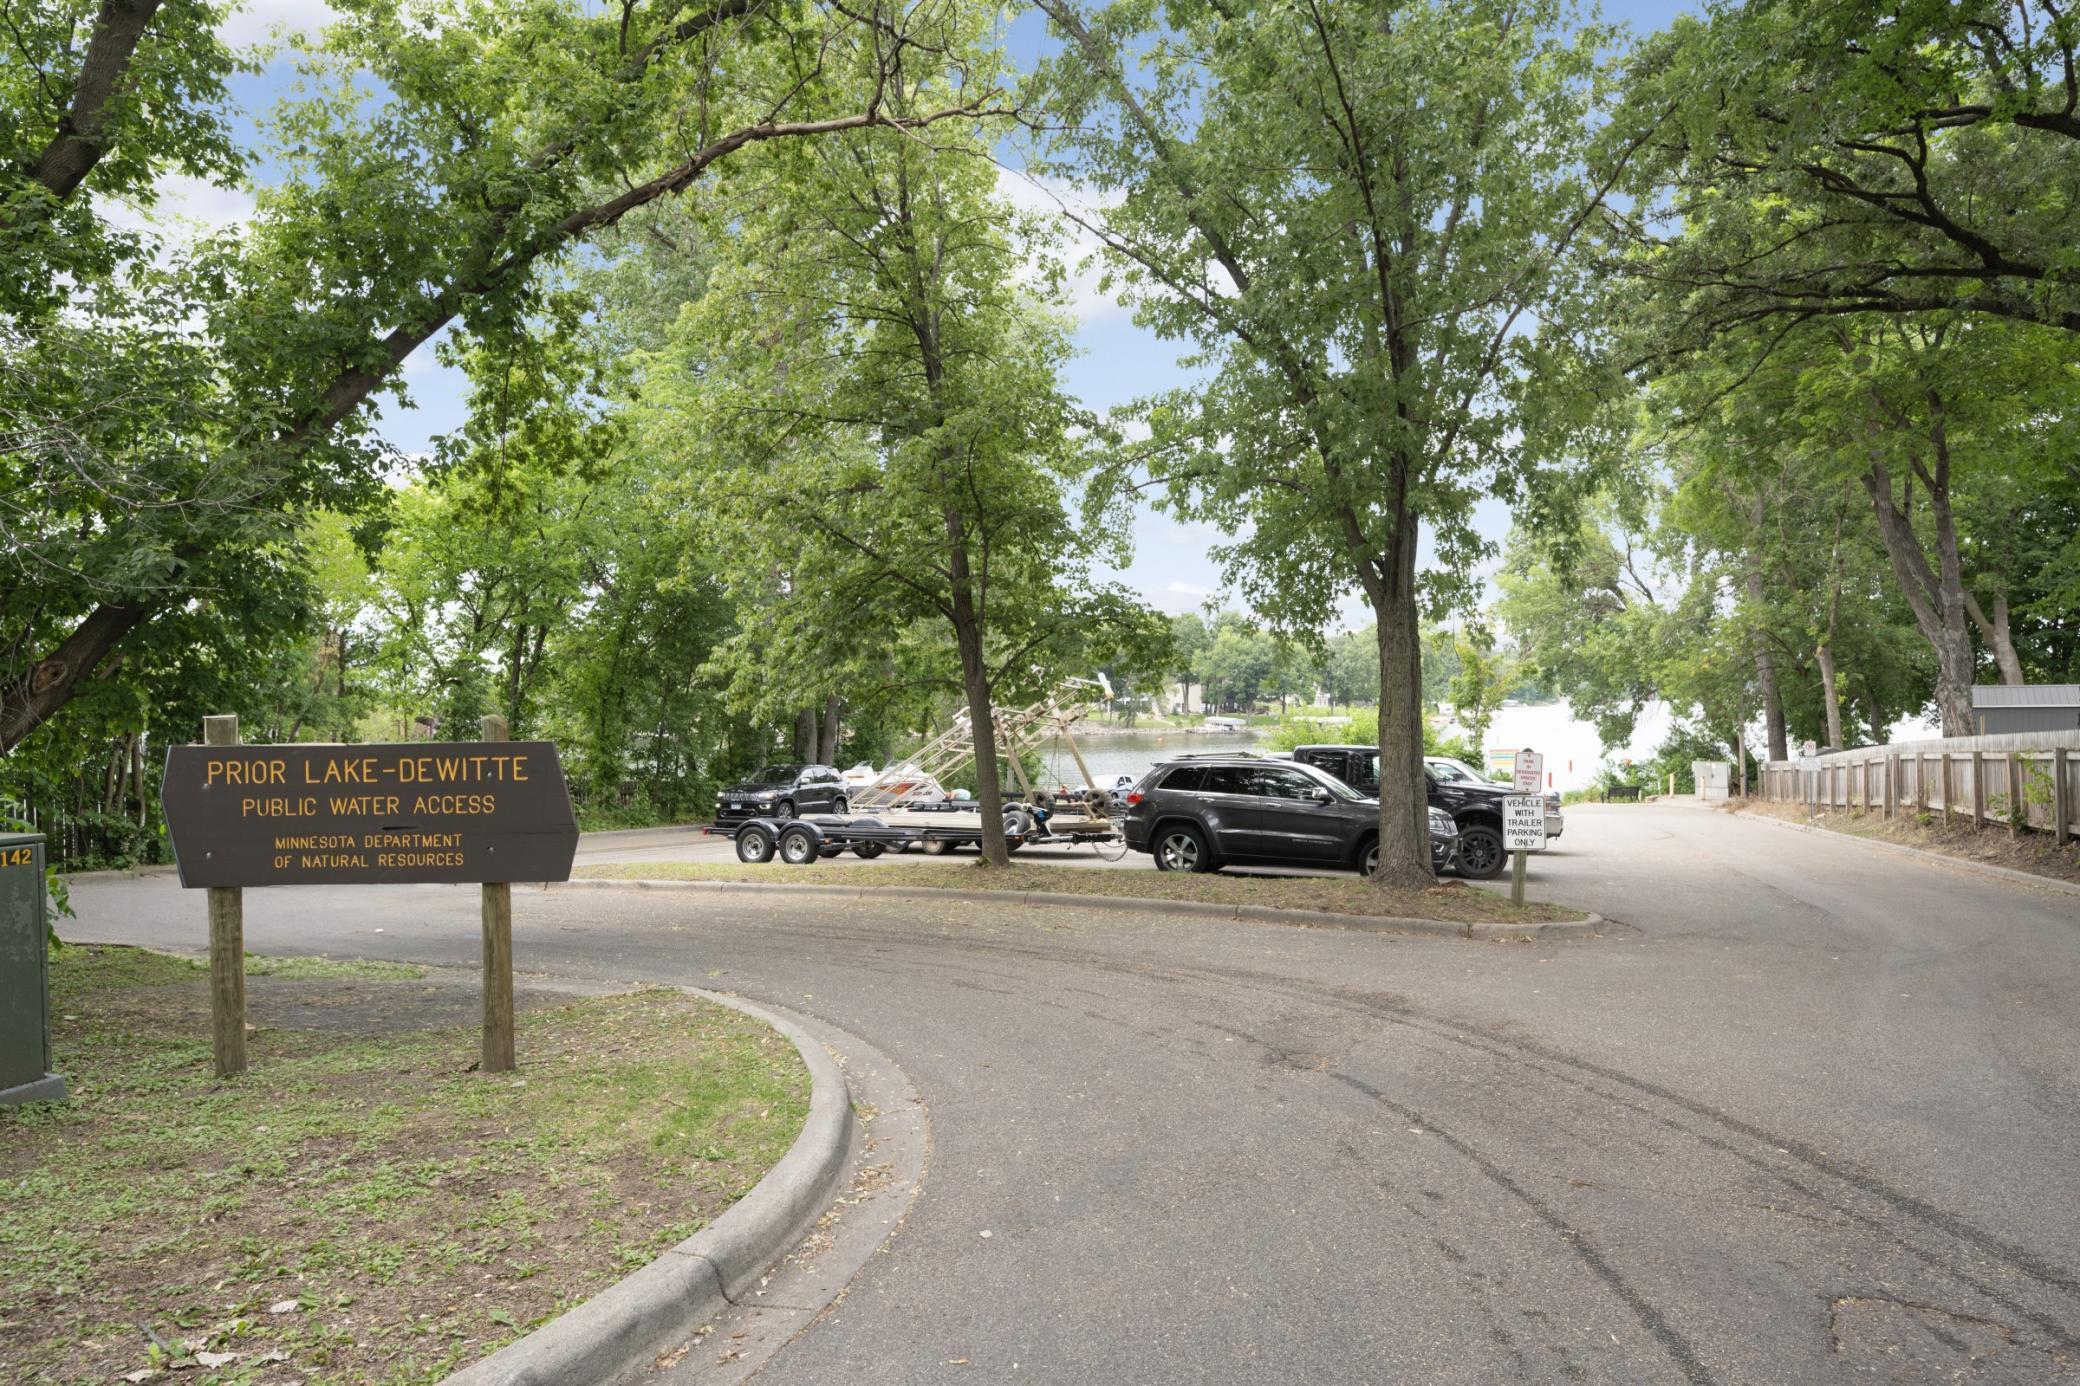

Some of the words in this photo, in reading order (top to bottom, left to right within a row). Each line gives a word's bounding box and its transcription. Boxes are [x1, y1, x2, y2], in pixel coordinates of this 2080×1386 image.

[207, 759, 286, 785] PRIOR
[304, 755, 529, 784] LAKE-DEWITTE
[242, 797, 317, 817] PUBLIC
[330, 796, 399, 816] WATER
[413, 795, 496, 815] ACCESS
[1507, 799, 1542, 808] VEHICLE
[1514, 809, 1535, 817] WITH
[1507, 819, 1542, 827] TRAILER
[1507, 828, 1543, 837] PARKING
[275, 835, 355, 849] MINNESOTA
[364, 833, 463, 848] DEPARTMENT
[1514, 838, 1536, 847] ONLY
[0, 848, 32, 867] 142
[274, 856, 292, 868] OF
[302, 854, 368, 868] NATURAL
[378, 852, 464, 867] RESOURCES
